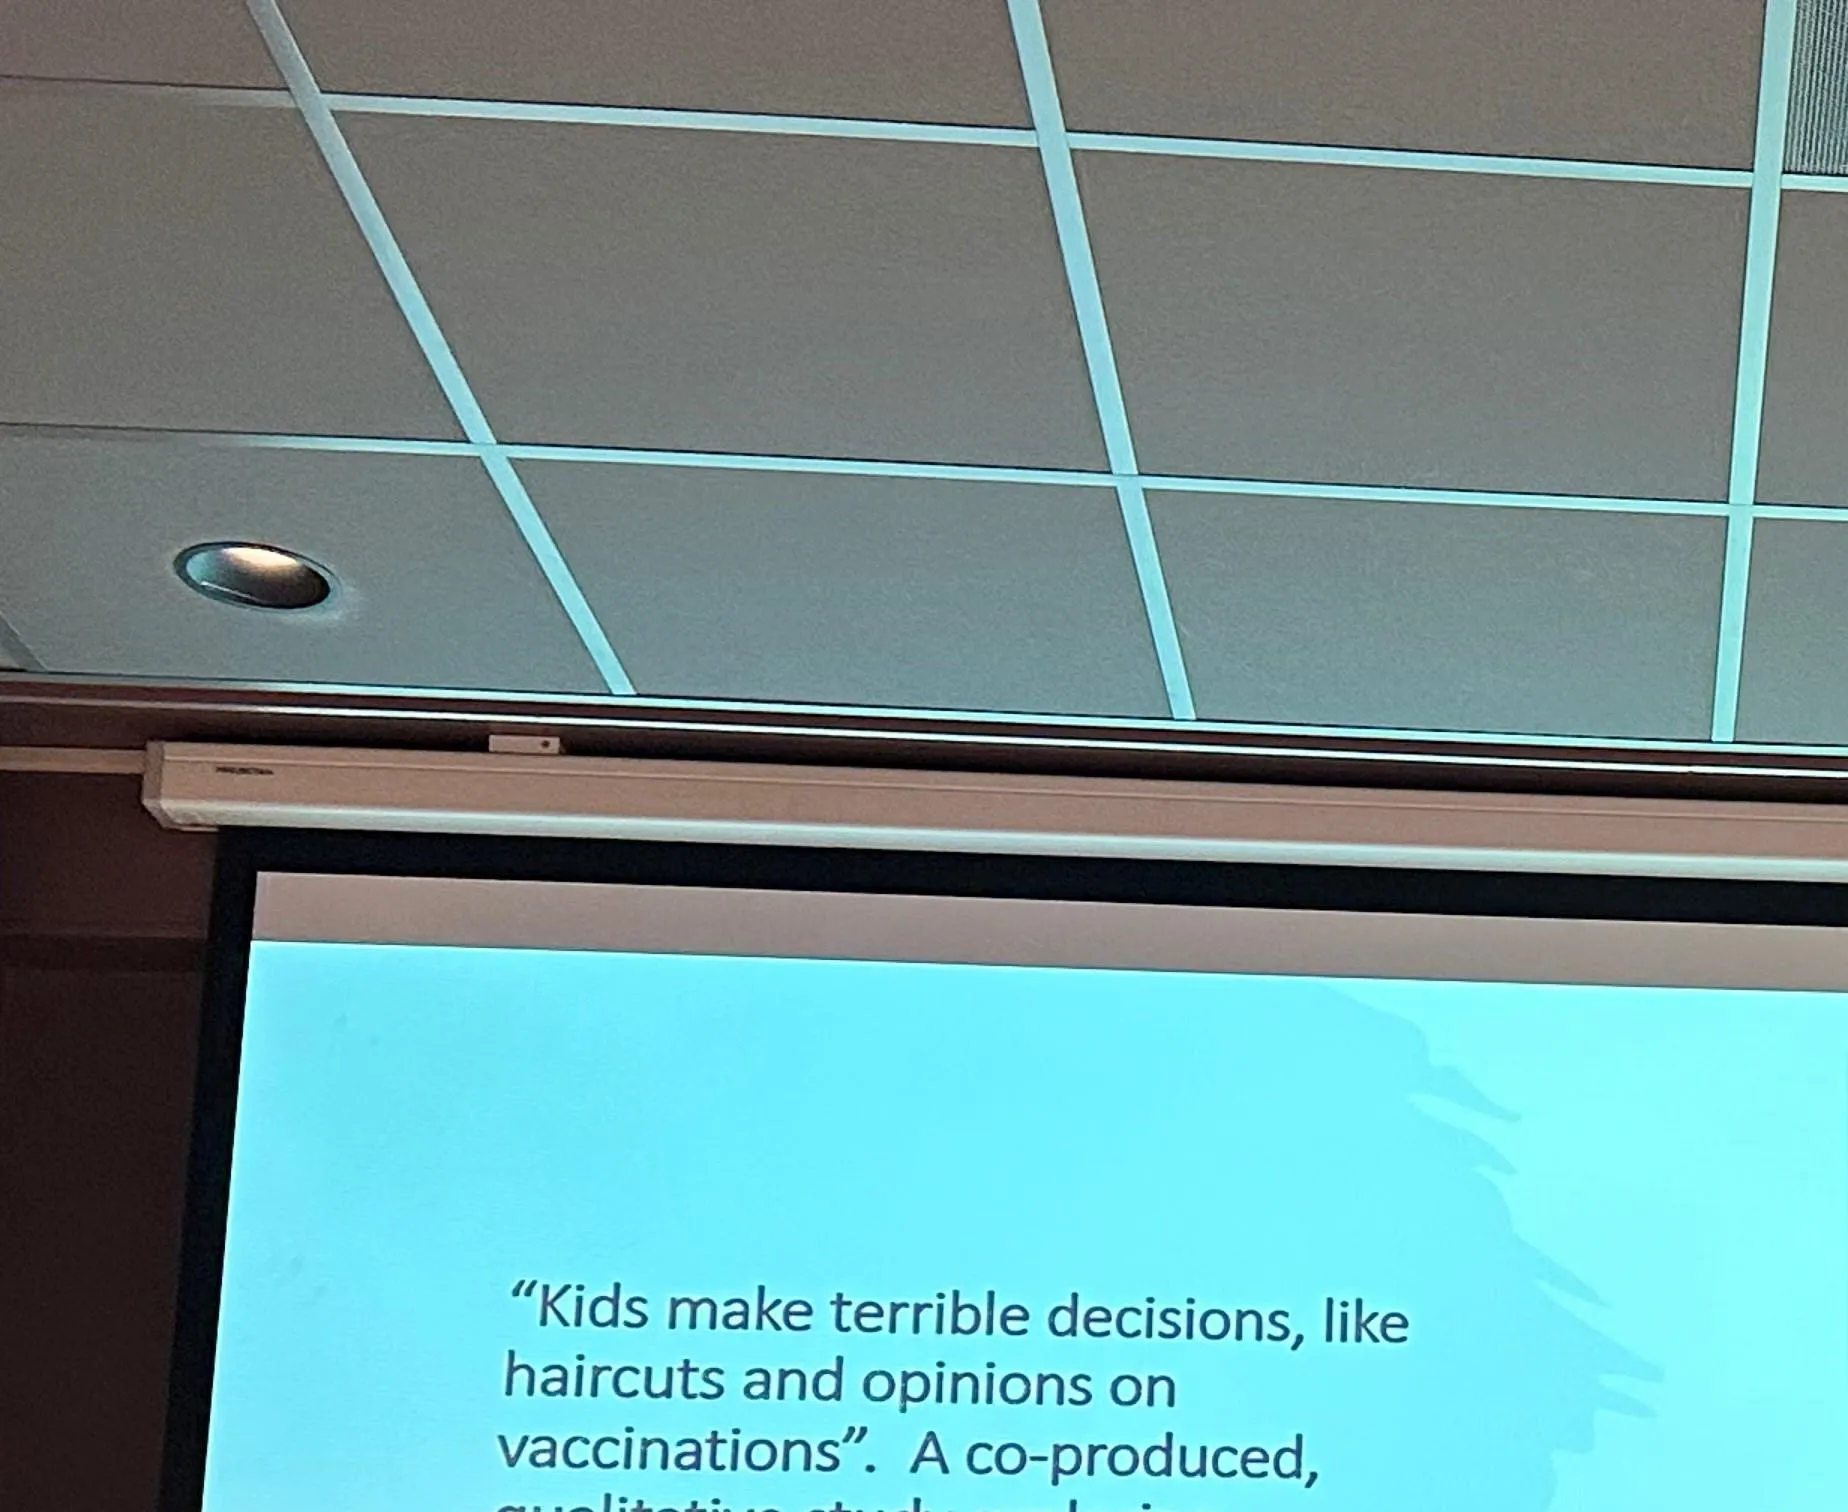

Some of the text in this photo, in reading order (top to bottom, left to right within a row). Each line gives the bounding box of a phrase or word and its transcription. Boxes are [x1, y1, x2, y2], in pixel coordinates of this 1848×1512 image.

[512, 1280, 1409, 1351] “Kids make terrible decisions, like
[505, 1350, 1175, 1413] haircuts and opinions on
[498, 1426, 1318, 1488] vaccinations”. A co-produced,
